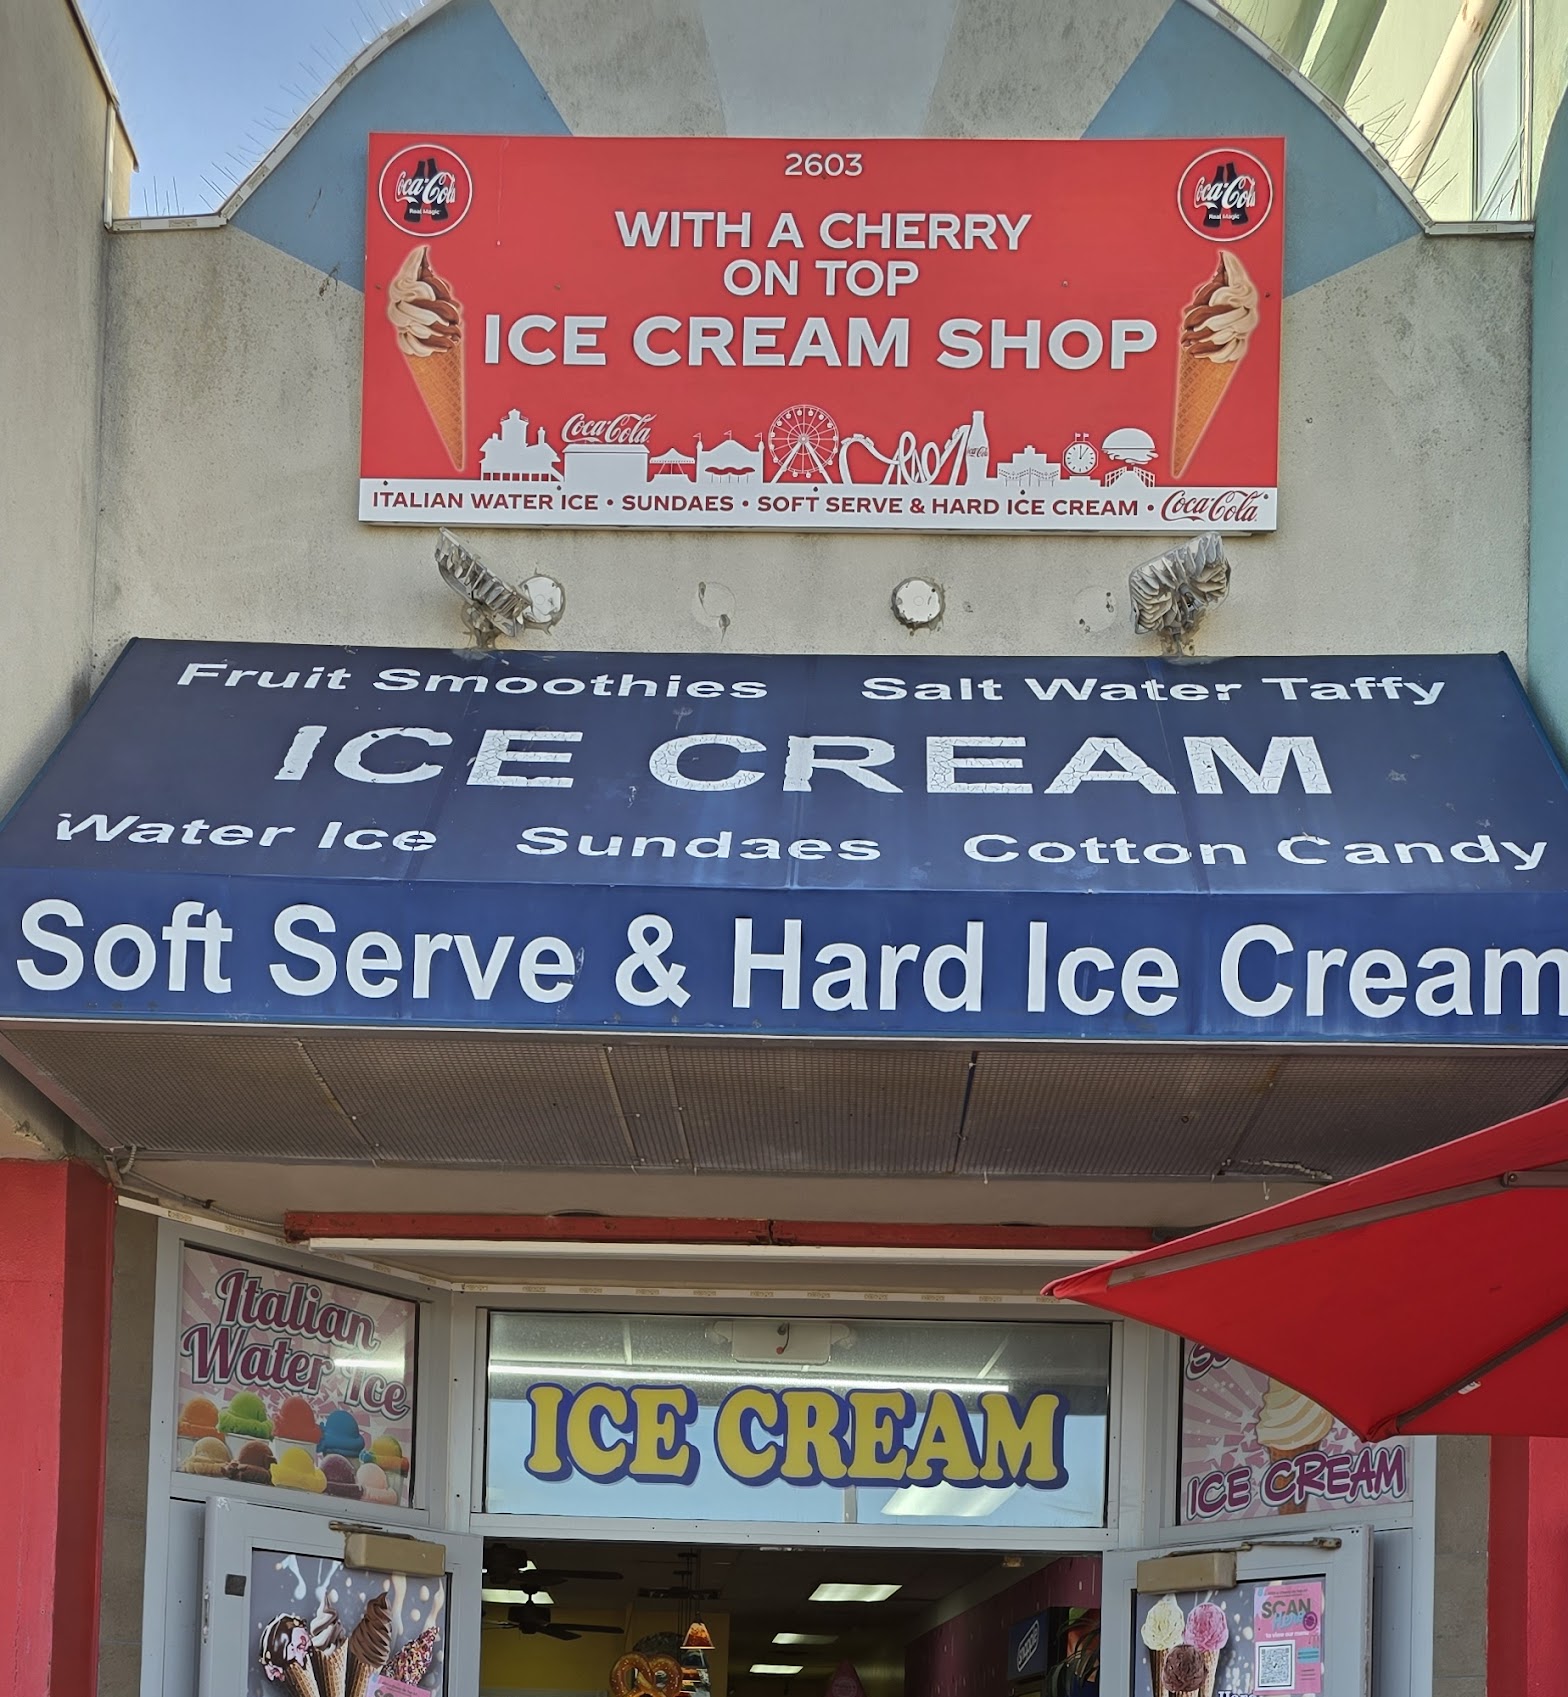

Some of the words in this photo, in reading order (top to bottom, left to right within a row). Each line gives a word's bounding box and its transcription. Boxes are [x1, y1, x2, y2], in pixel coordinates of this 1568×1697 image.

[785, 153, 863, 177] 2603
[615, 210, 752, 249] WITH
[767, 212, 805, 249] A
[819, 212, 1032, 251] CHERRY
[723, 259, 798, 296] ON
[814, 260, 919, 297] TOP
[485, 313, 608, 367] ICE
[632, 316, 909, 368] CREAM
[936, 318, 1158, 371] SHOP
[561, 412, 658, 445] Coca-Cola
[372, 491, 464, 509] ITALIAN
[470, 493, 553, 511] WATER
[561, 493, 599, 511] ICE
[621, 494, 735, 513] SUNDAES
[757, 496, 820, 514] SOFT
[825, 496, 903, 514] SERVE
[909, 497, 926, 514] &
[931, 498, 1000, 516] HARD
[1006, 498, 1048, 516] ICE
[1052, 499, 1138, 517] CREAM
[1160, 489, 1267, 523] Coca-Cola
[177, 662, 351, 692] Fruit
[372, 668, 769, 700] Smoothies
[861, 677, 1004, 701] Salt
[1024, 677, 1243, 702] Water
[1262, 677, 1447, 706] Taffy
[274, 724, 584, 788] ICE
[648, 732, 1333, 796] CREAM
[56, 812, 296, 849] Water
[317, 820, 438, 853] Ice
[516, 826, 882, 862] Sundaes
[963, 833, 1248, 866] Cotton
[1276, 834, 1548, 871] Candy
[16, 898, 234, 995] Soft
[269, 903, 577, 1004] Serve
[614, 913, 692, 1008] &
[733, 916, 985, 1013] Hard
[1026, 920, 1181, 1017] Ice
[1219, 923, 1568, 1019] Cream
[217, 1270, 379, 1351] Italian
[181, 1324, 334, 1394] Water
[343, 1361, 410, 1419] Ice
[524, 1382, 699, 1485] ICE
[713, 1384, 1070, 1490] CREAM
[1187, 1466, 1251, 1520] ICE
[1260, 1445, 1407, 1507] CREAM
[1261, 1597, 1311, 1619] SCAN
